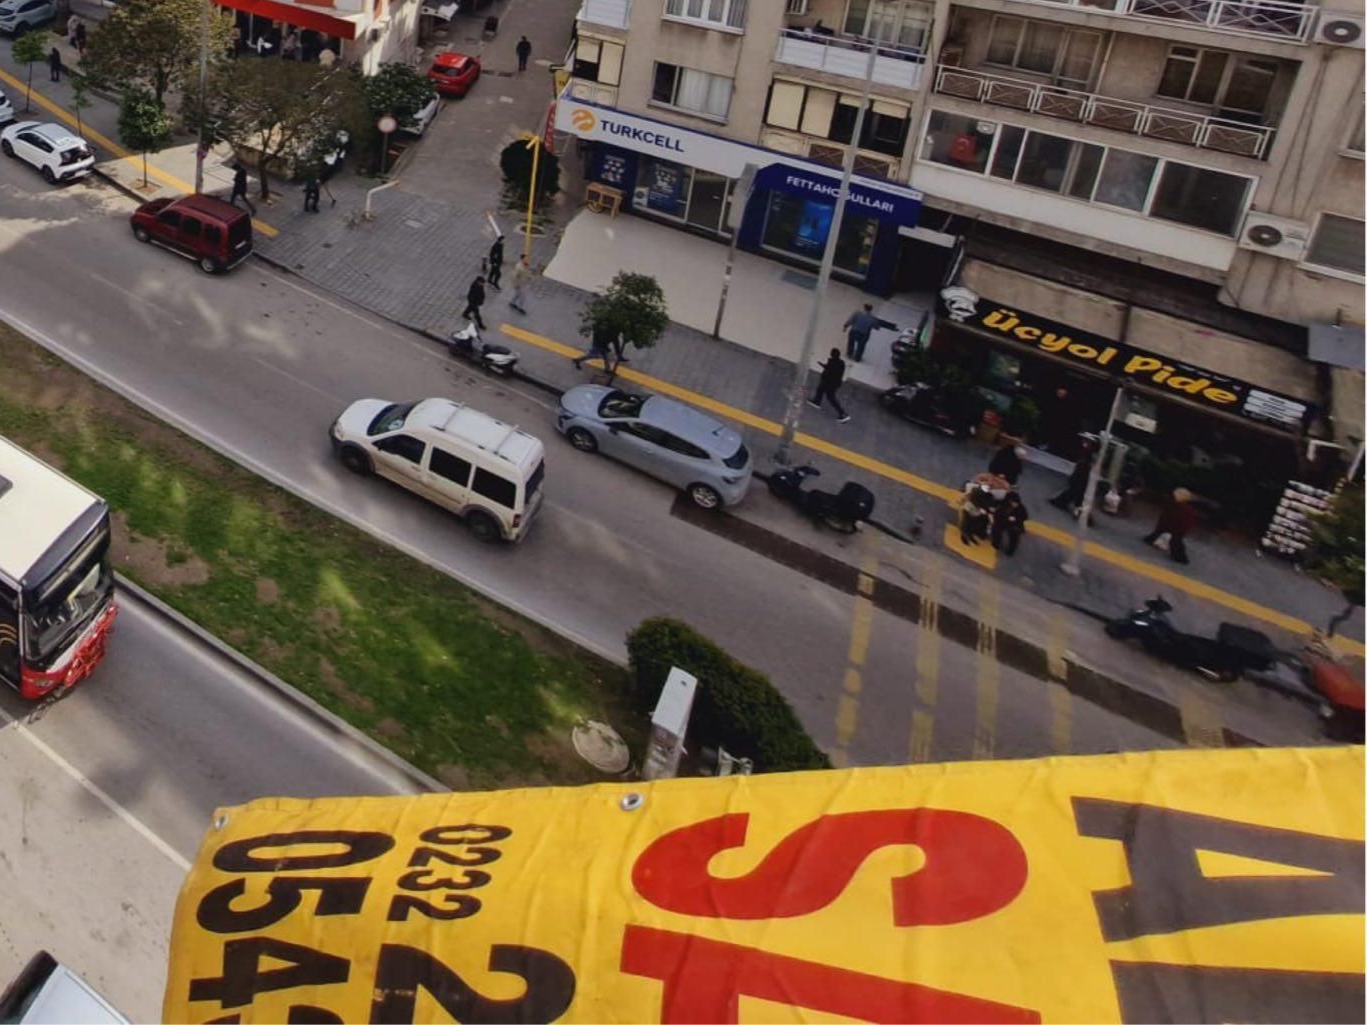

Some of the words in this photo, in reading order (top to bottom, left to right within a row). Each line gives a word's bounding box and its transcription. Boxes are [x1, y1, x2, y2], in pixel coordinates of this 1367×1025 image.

[600, 119, 685, 153] TURKCELL
[786, 175, 895, 213] FETTAHOULLARI
[1123, 355, 1238, 405] Pide
[386, 823, 513, 922] 0232
[188, 829, 396, 1024] 054
